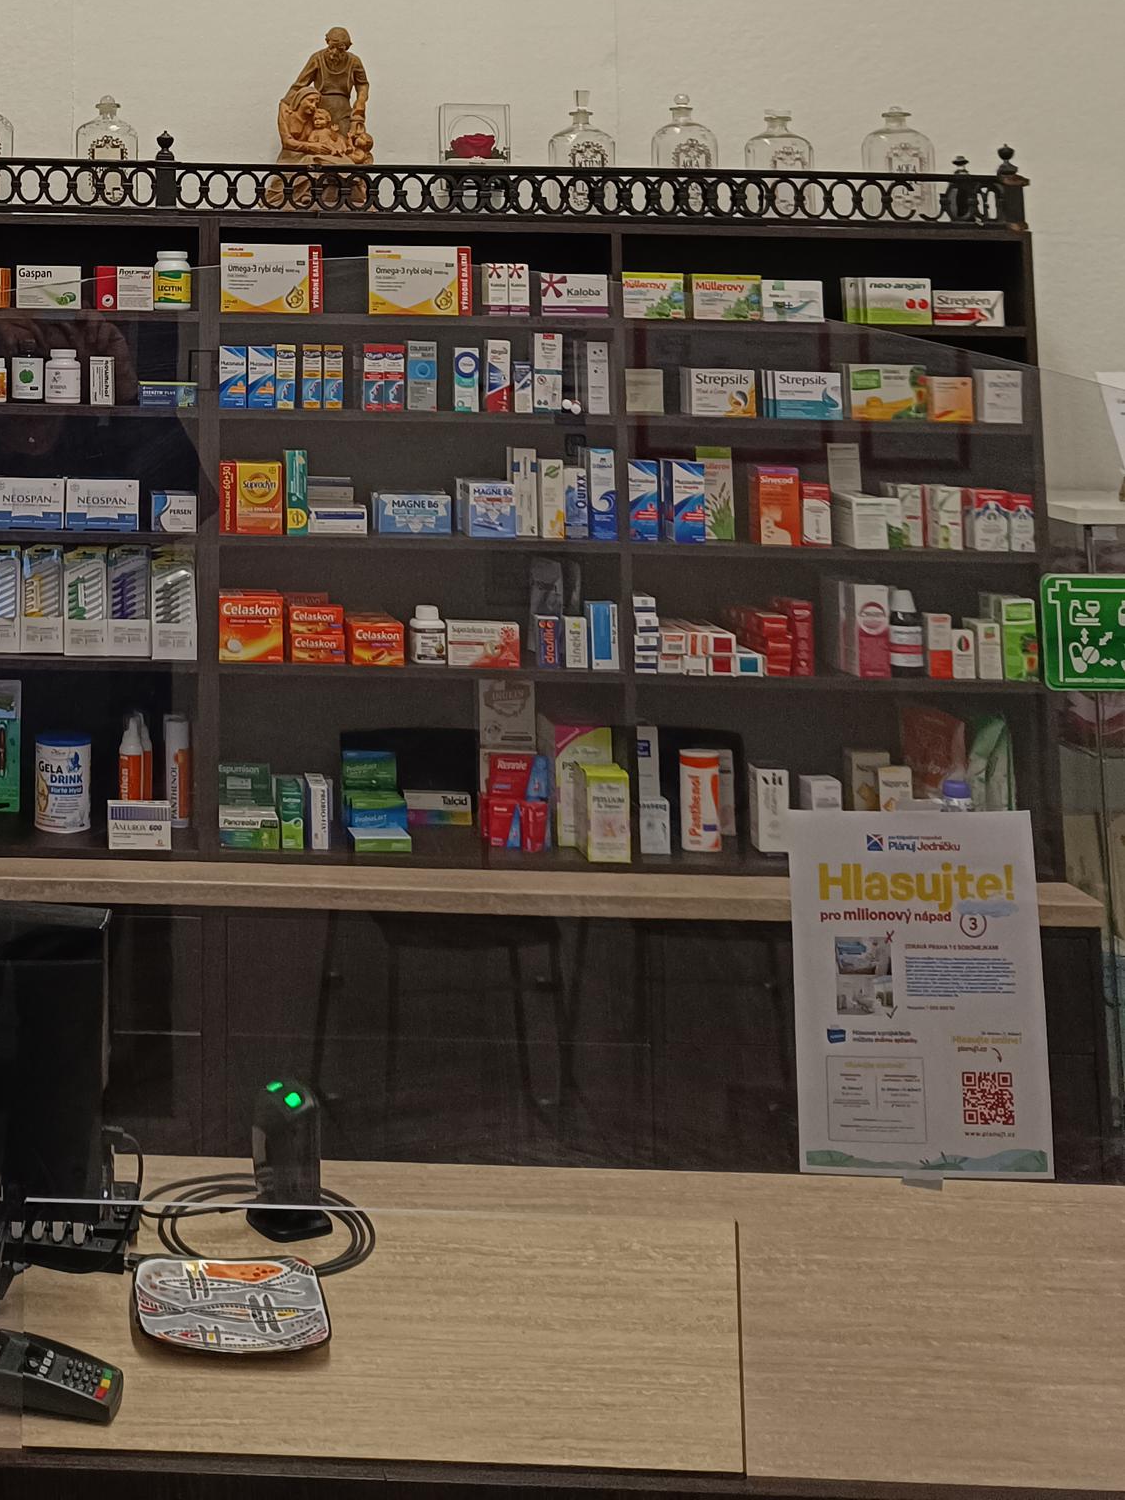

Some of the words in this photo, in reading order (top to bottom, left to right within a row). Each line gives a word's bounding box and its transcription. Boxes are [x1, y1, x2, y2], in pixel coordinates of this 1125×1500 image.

[18, 267, 53, 280] Gaspan
[227, 264, 257, 274] Omega-3
[157, 284, 183, 292] LECITIN
[567, 287, 601, 297] Kaloba
[695, 280, 745, 293] Müllerovy
[695, 373, 749, 387] Strepsils
[778, 374, 827, 387] Strepsils
[759, 475, 794, 484] Sinecod
[473, 487, 502, 496] MAGNE
[502, 488, 513, 496] B6
[576, 475, 586, 509] QUIXX
[2, 494, 52, 504] NEOSPAN
[76, 496, 127, 505] NEOSPAN
[392, 499, 426, 509] MAGNE
[427, 500, 439, 508] B6
[222, 602, 280, 617] Celaskon
[292, 611, 335, 622] Celaskon
[355, 629, 400, 641] Celaskon
[294, 638, 337, 649] Celaskon
[38, 761, 64, 774] GELA
[496, 758, 528, 771] Rennie
[50, 773, 83, 785] DRINK
[441, 795, 468, 806] Talcid
[888, 841, 916, 852] Plánuj
[917, 840, 961, 851] Jedničku
[818, 861, 1015, 912] Hlasujte!
[820, 911, 841, 922] pro
[843, 908, 912, 924] milionový
[914, 909, 952, 923] nápad
[969, 917, 978, 931] 3
